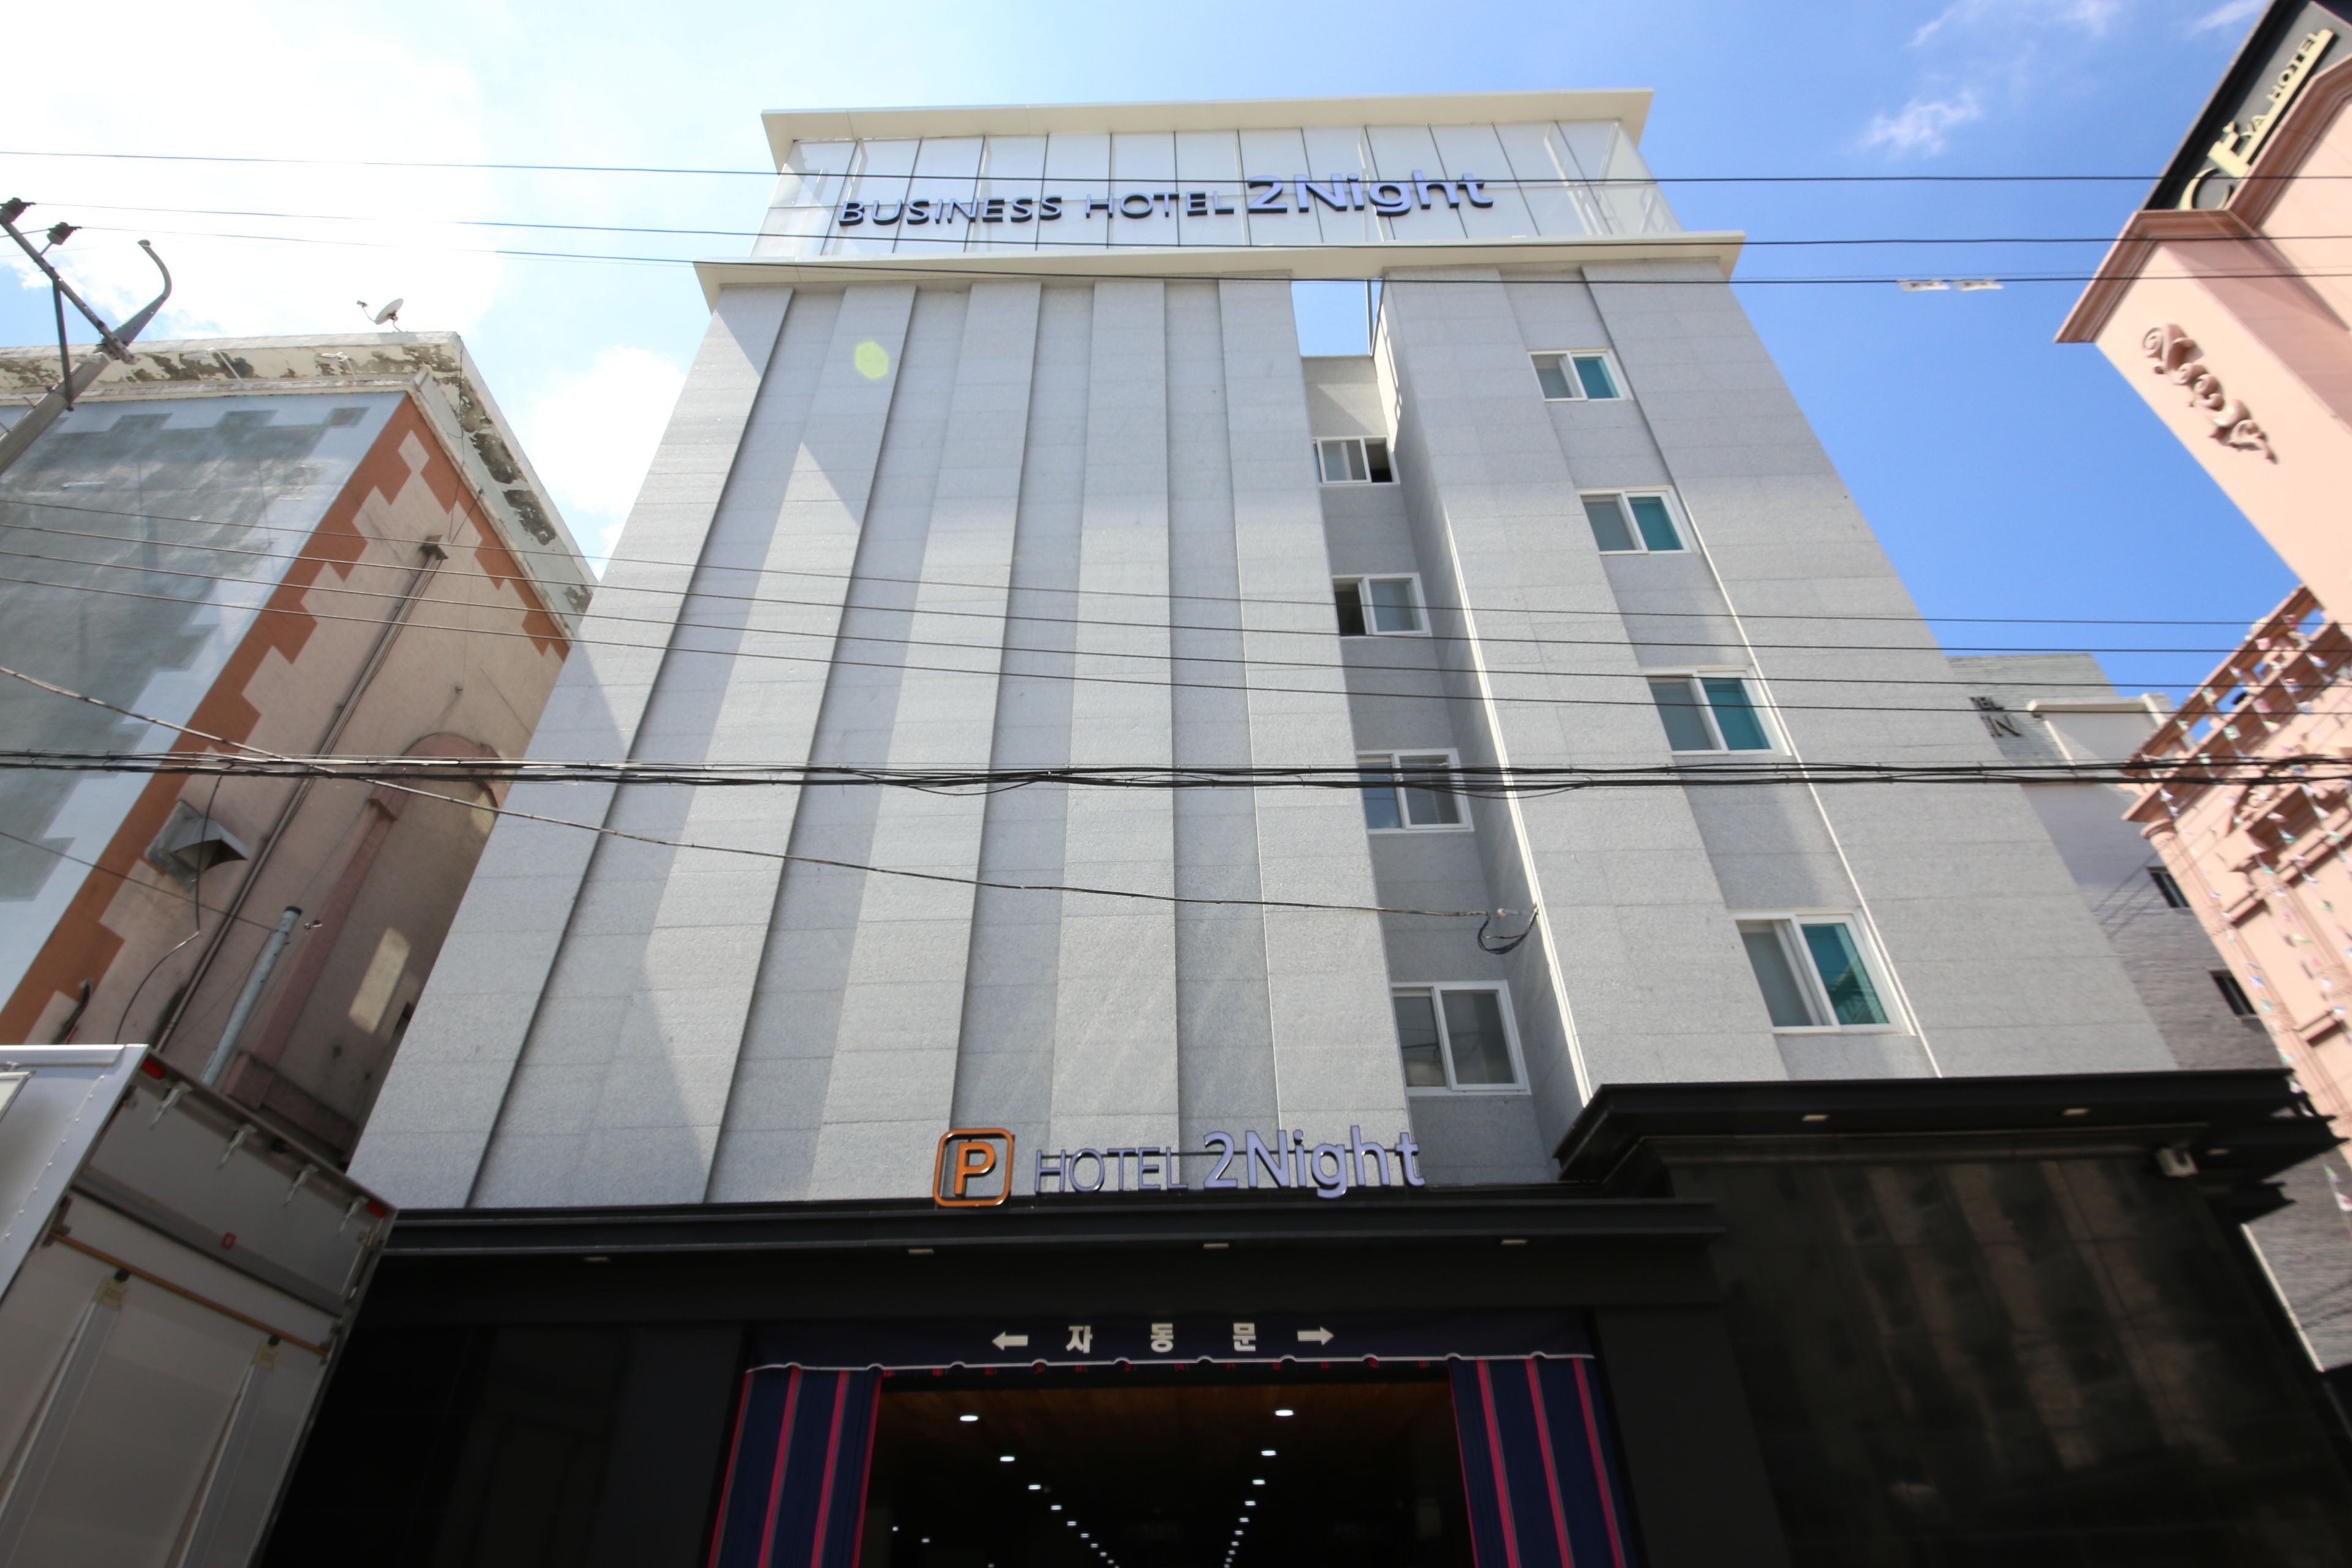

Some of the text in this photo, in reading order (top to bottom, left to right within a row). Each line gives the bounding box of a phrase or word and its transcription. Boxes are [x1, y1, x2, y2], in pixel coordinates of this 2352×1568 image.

[2266, 32, 2318, 103] HOTEL
[838, 169, 1494, 227] BUSINESS HOTEL 2Night
[954, 1125, 1425, 1198] P HOTEL 2Night
